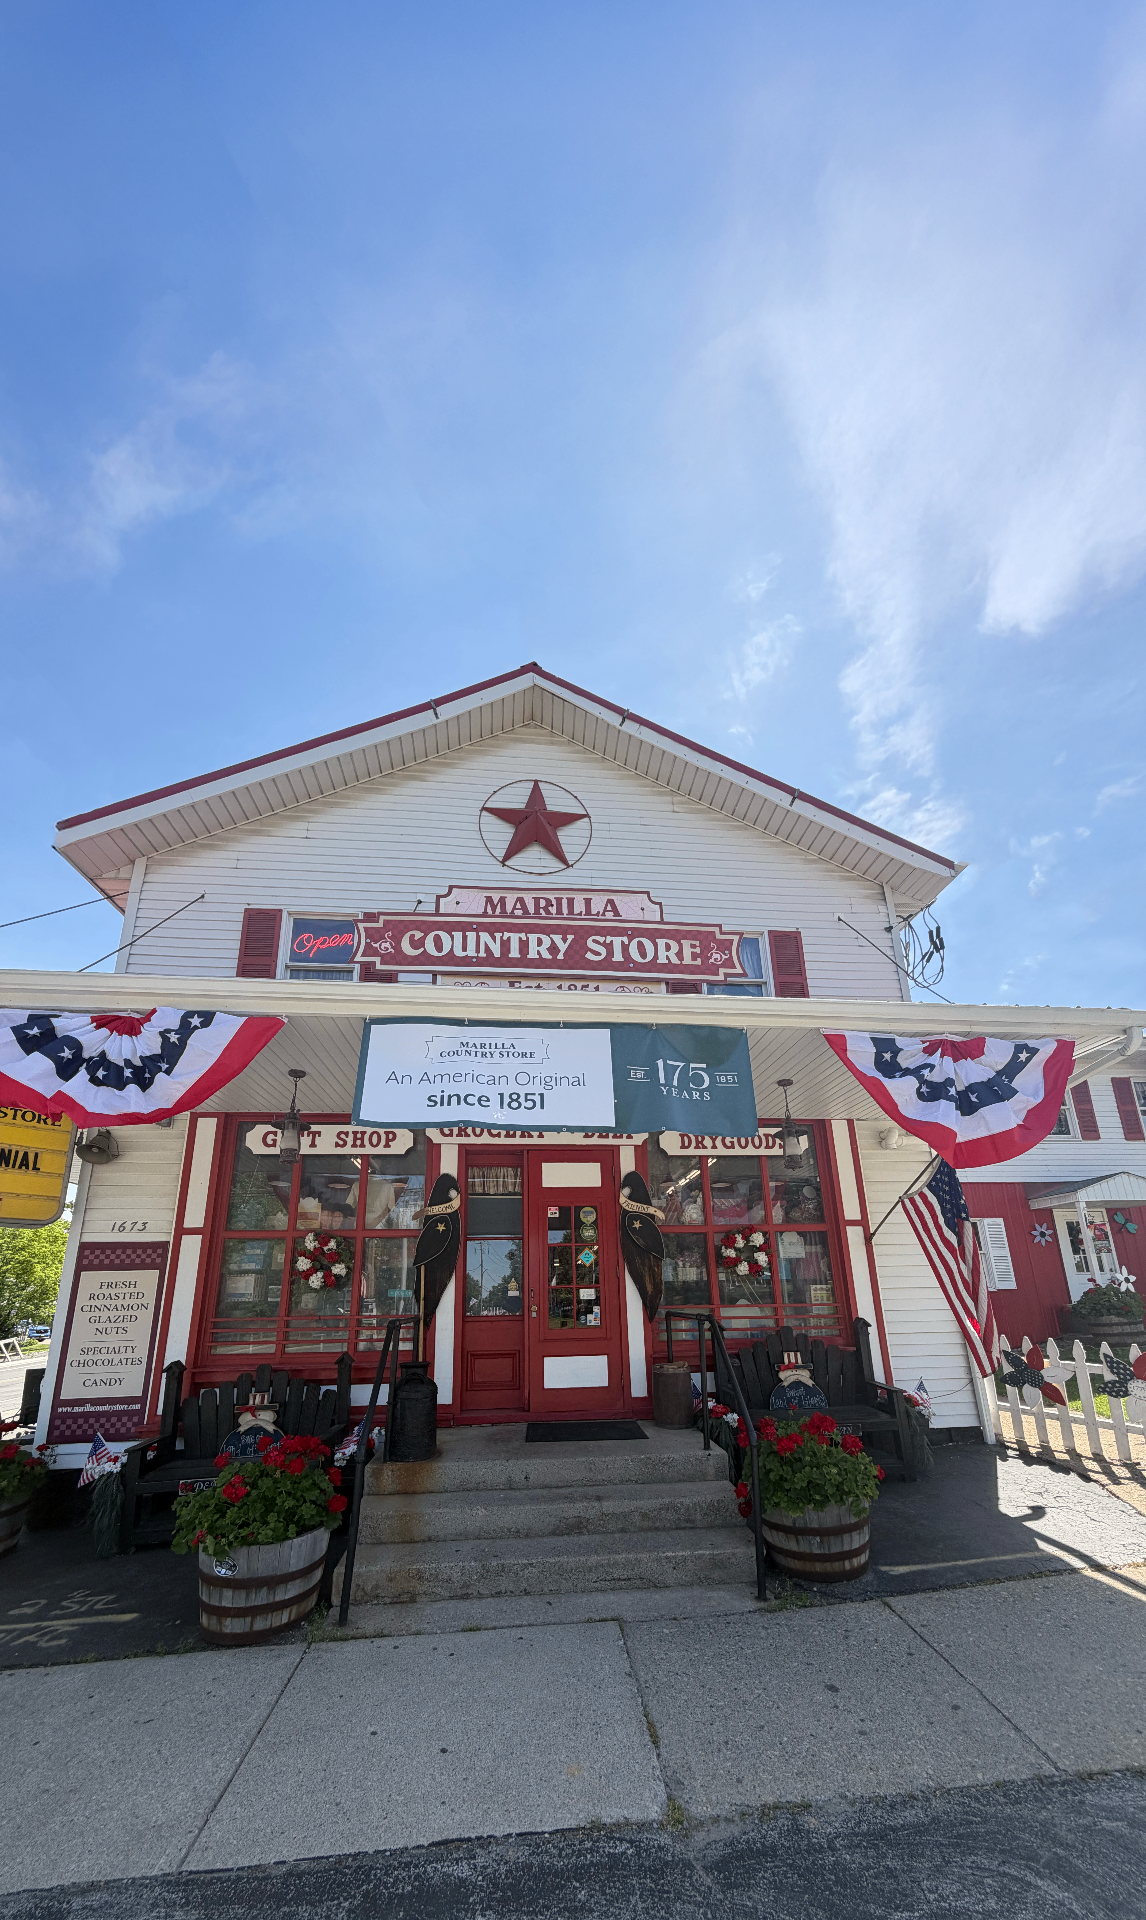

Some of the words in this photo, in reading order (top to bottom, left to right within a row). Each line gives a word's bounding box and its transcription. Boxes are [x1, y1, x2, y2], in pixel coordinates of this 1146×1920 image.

[483, 895, 623, 918] MARILLA
[293, 931, 354, 958] Open
[401, 929, 575, 960] COUNTRY
[585, 935, 702, 966] STORE
[458, 1041, 517, 1050] MARILLA
[439, 1050, 498, 1059] COUNTRY
[498, 1050, 536, 1059] STORE
[385, 1070, 413, 1085] An
[418, 1069, 509, 1086] American
[514, 1071, 586, 1091] Original
[655, 1058, 710, 1090] 175
[716, 1075, 738, 1083] 1851
[660, 1086, 711, 1101] YEARS
[426, 1090, 491, 1108] since
[497, 1092, 545, 1110] 1851
[261, 1130, 322, 1148] GT
[334, 1130, 398, 1148] SHOP
[622, 1199, 650, 1212] FRIENDS
[111, 1220, 149, 1233] 1673
[99, 1280, 138, 1290] FRESH
[88, 1291, 145, 1301] ROASTED
[80, 1302, 150, 1313] CINNAMON
[88, 1314, 138, 1325] GLAZED
[94, 1326, 129, 1336] NUTS
[79, 1345, 137, 1356] SPECIALTY
[69, 1356, 143, 1368] CHOCOLATES
[82, 1377, 125, 1388] CANDY
